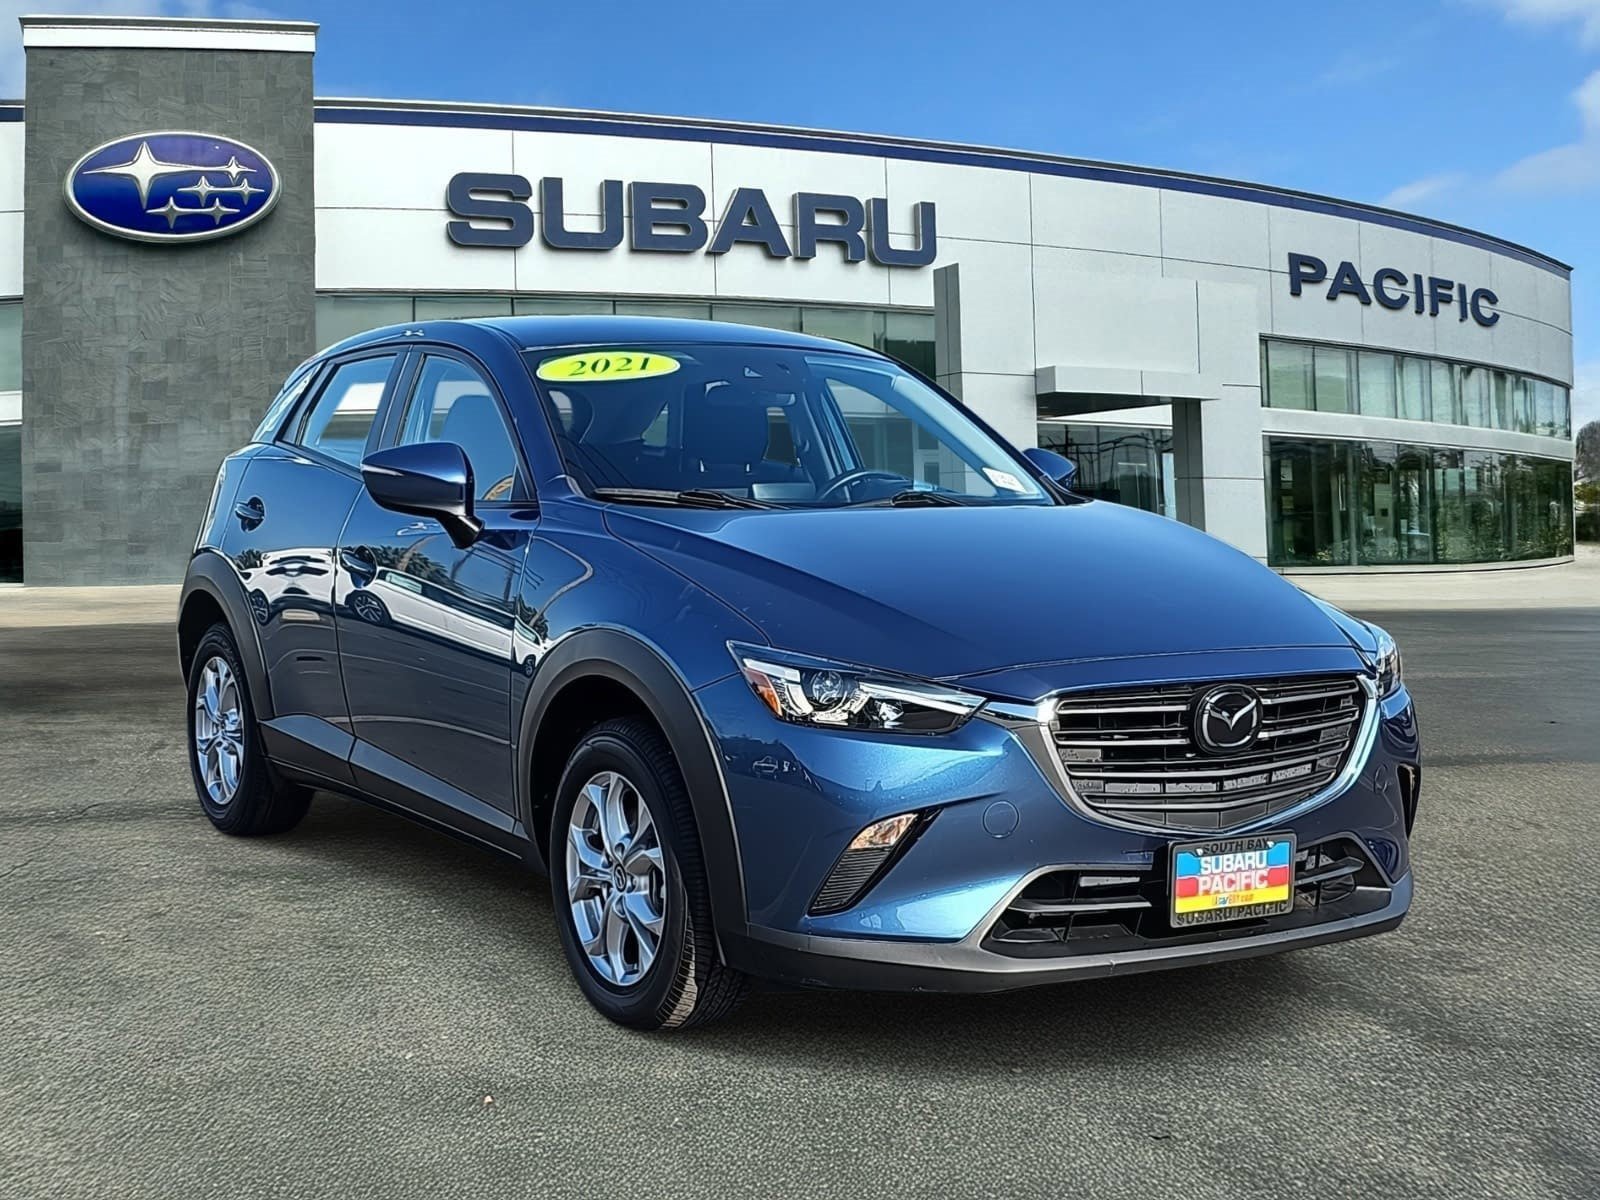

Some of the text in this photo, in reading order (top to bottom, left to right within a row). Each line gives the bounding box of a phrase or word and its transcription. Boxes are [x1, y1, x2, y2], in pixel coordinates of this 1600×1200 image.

[447, 172, 936, 268] SUBARU
[1288, 252, 1500, 327] PACIFIC
[568, 356, 650, 376] 2021
[1203, 838, 1270, 854] SOUTH BAY
[1201, 850, 1267, 874] SUBARU
[1198, 869, 1268, 896] PACIFIC
[1176, 902, 1288, 925] SUBARU PACIFIC
